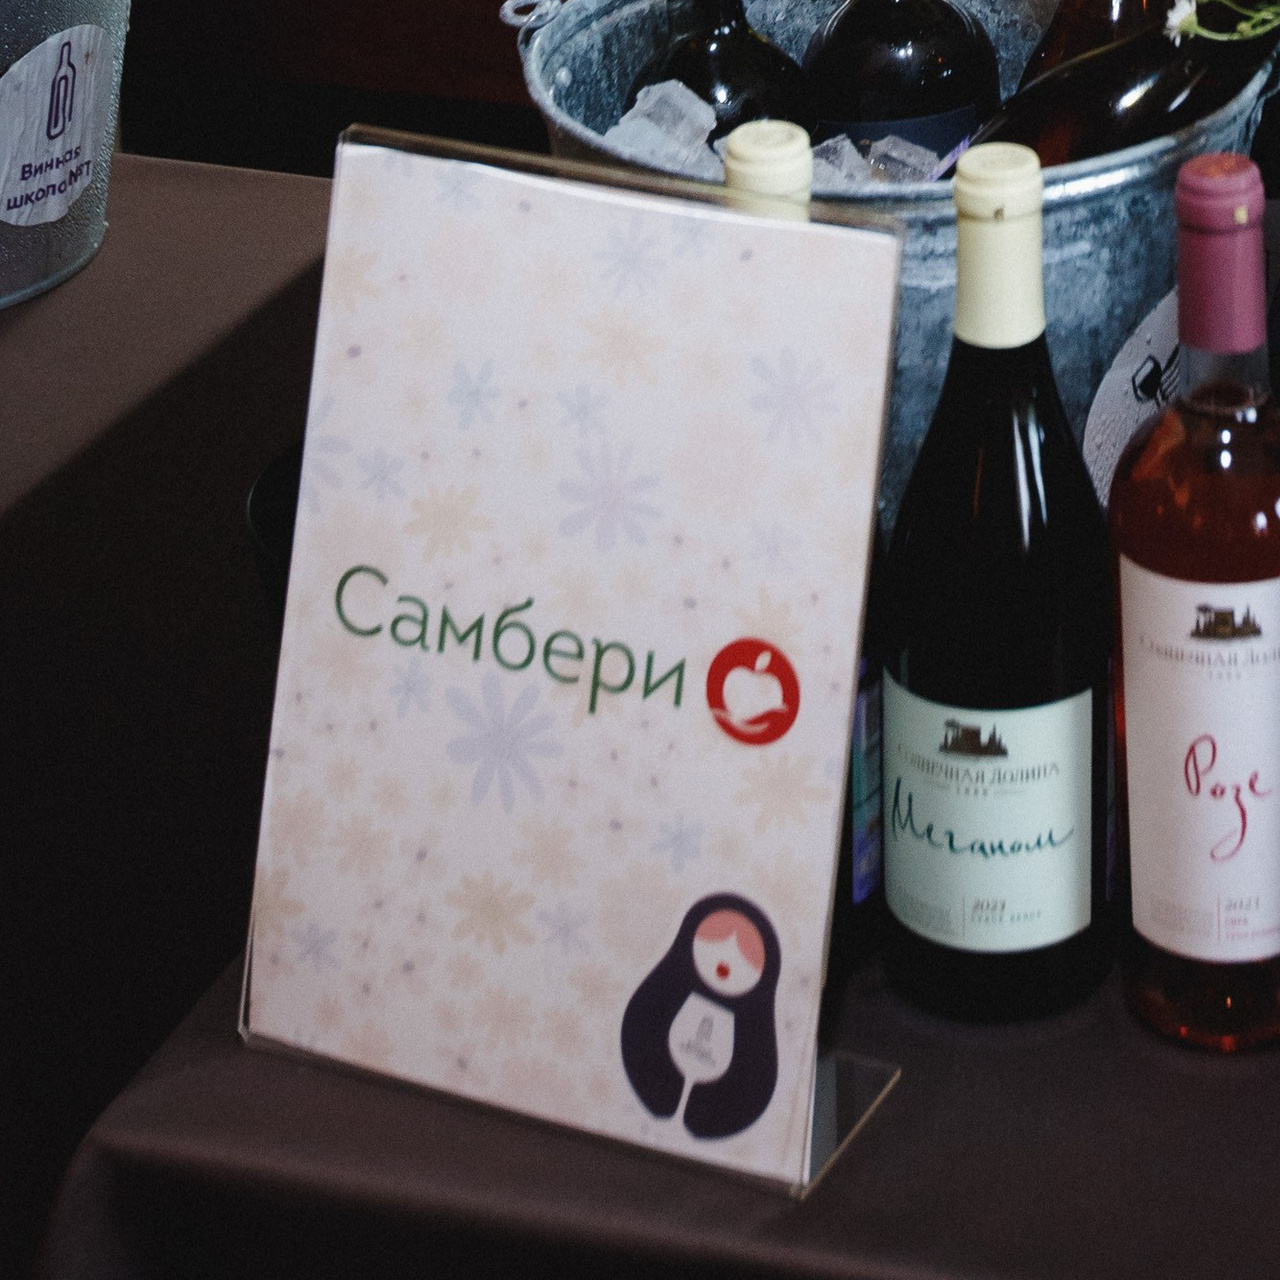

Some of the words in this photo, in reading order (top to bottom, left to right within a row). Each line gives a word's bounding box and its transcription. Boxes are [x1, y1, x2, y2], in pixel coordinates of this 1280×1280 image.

[6, 180, 67, 212] школа
[20, 145, 82, 181] Винная
[334, 563, 687, 716] Самбери
[890, 775, 1075, 859] Меганом
[1184, 733, 1273, 863] Розе
